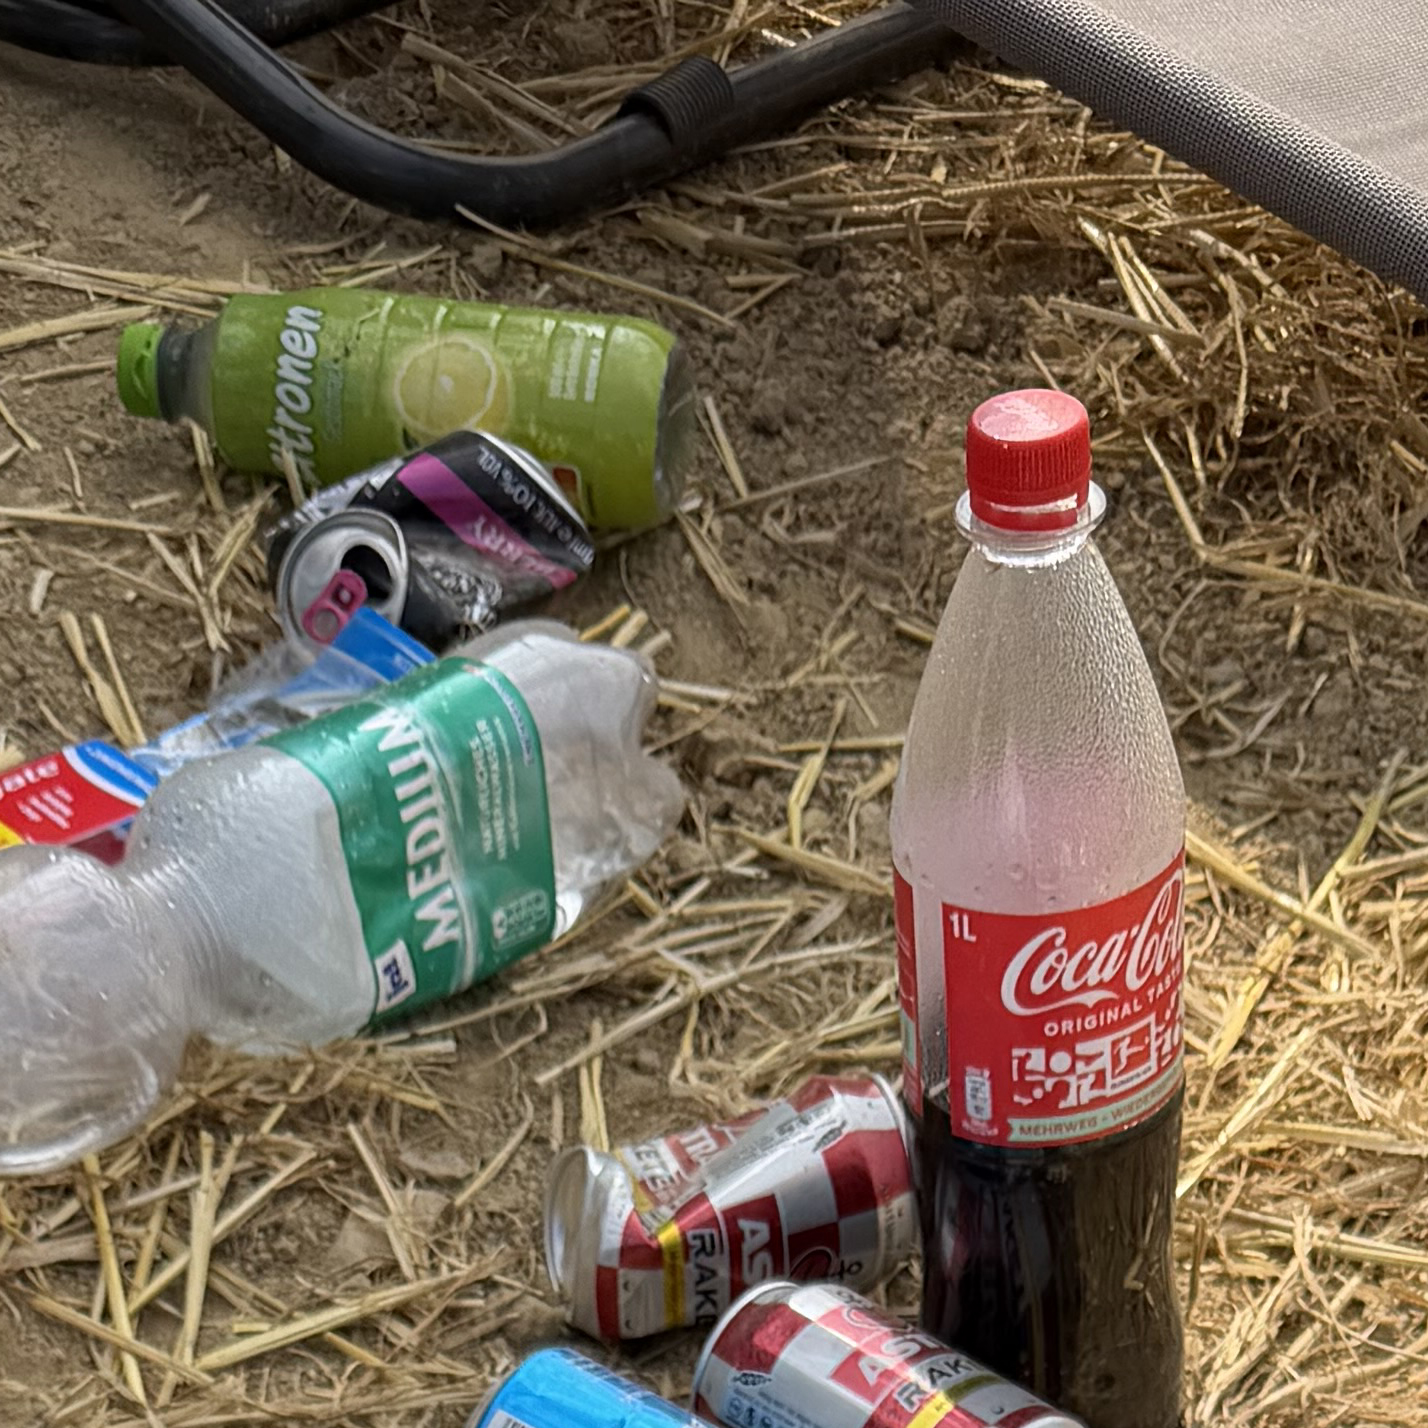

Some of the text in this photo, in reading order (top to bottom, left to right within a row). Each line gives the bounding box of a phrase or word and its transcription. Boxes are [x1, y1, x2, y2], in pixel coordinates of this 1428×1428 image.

[266, 305, 324, 488] tronen
[357, 705, 461, 952] MEDIUM
[949, 912, 977, 942] 1L
[1043, 997, 1143, 1037] ORIGINAL
[1018, 1118, 1099, 1138] MEHRWEG
